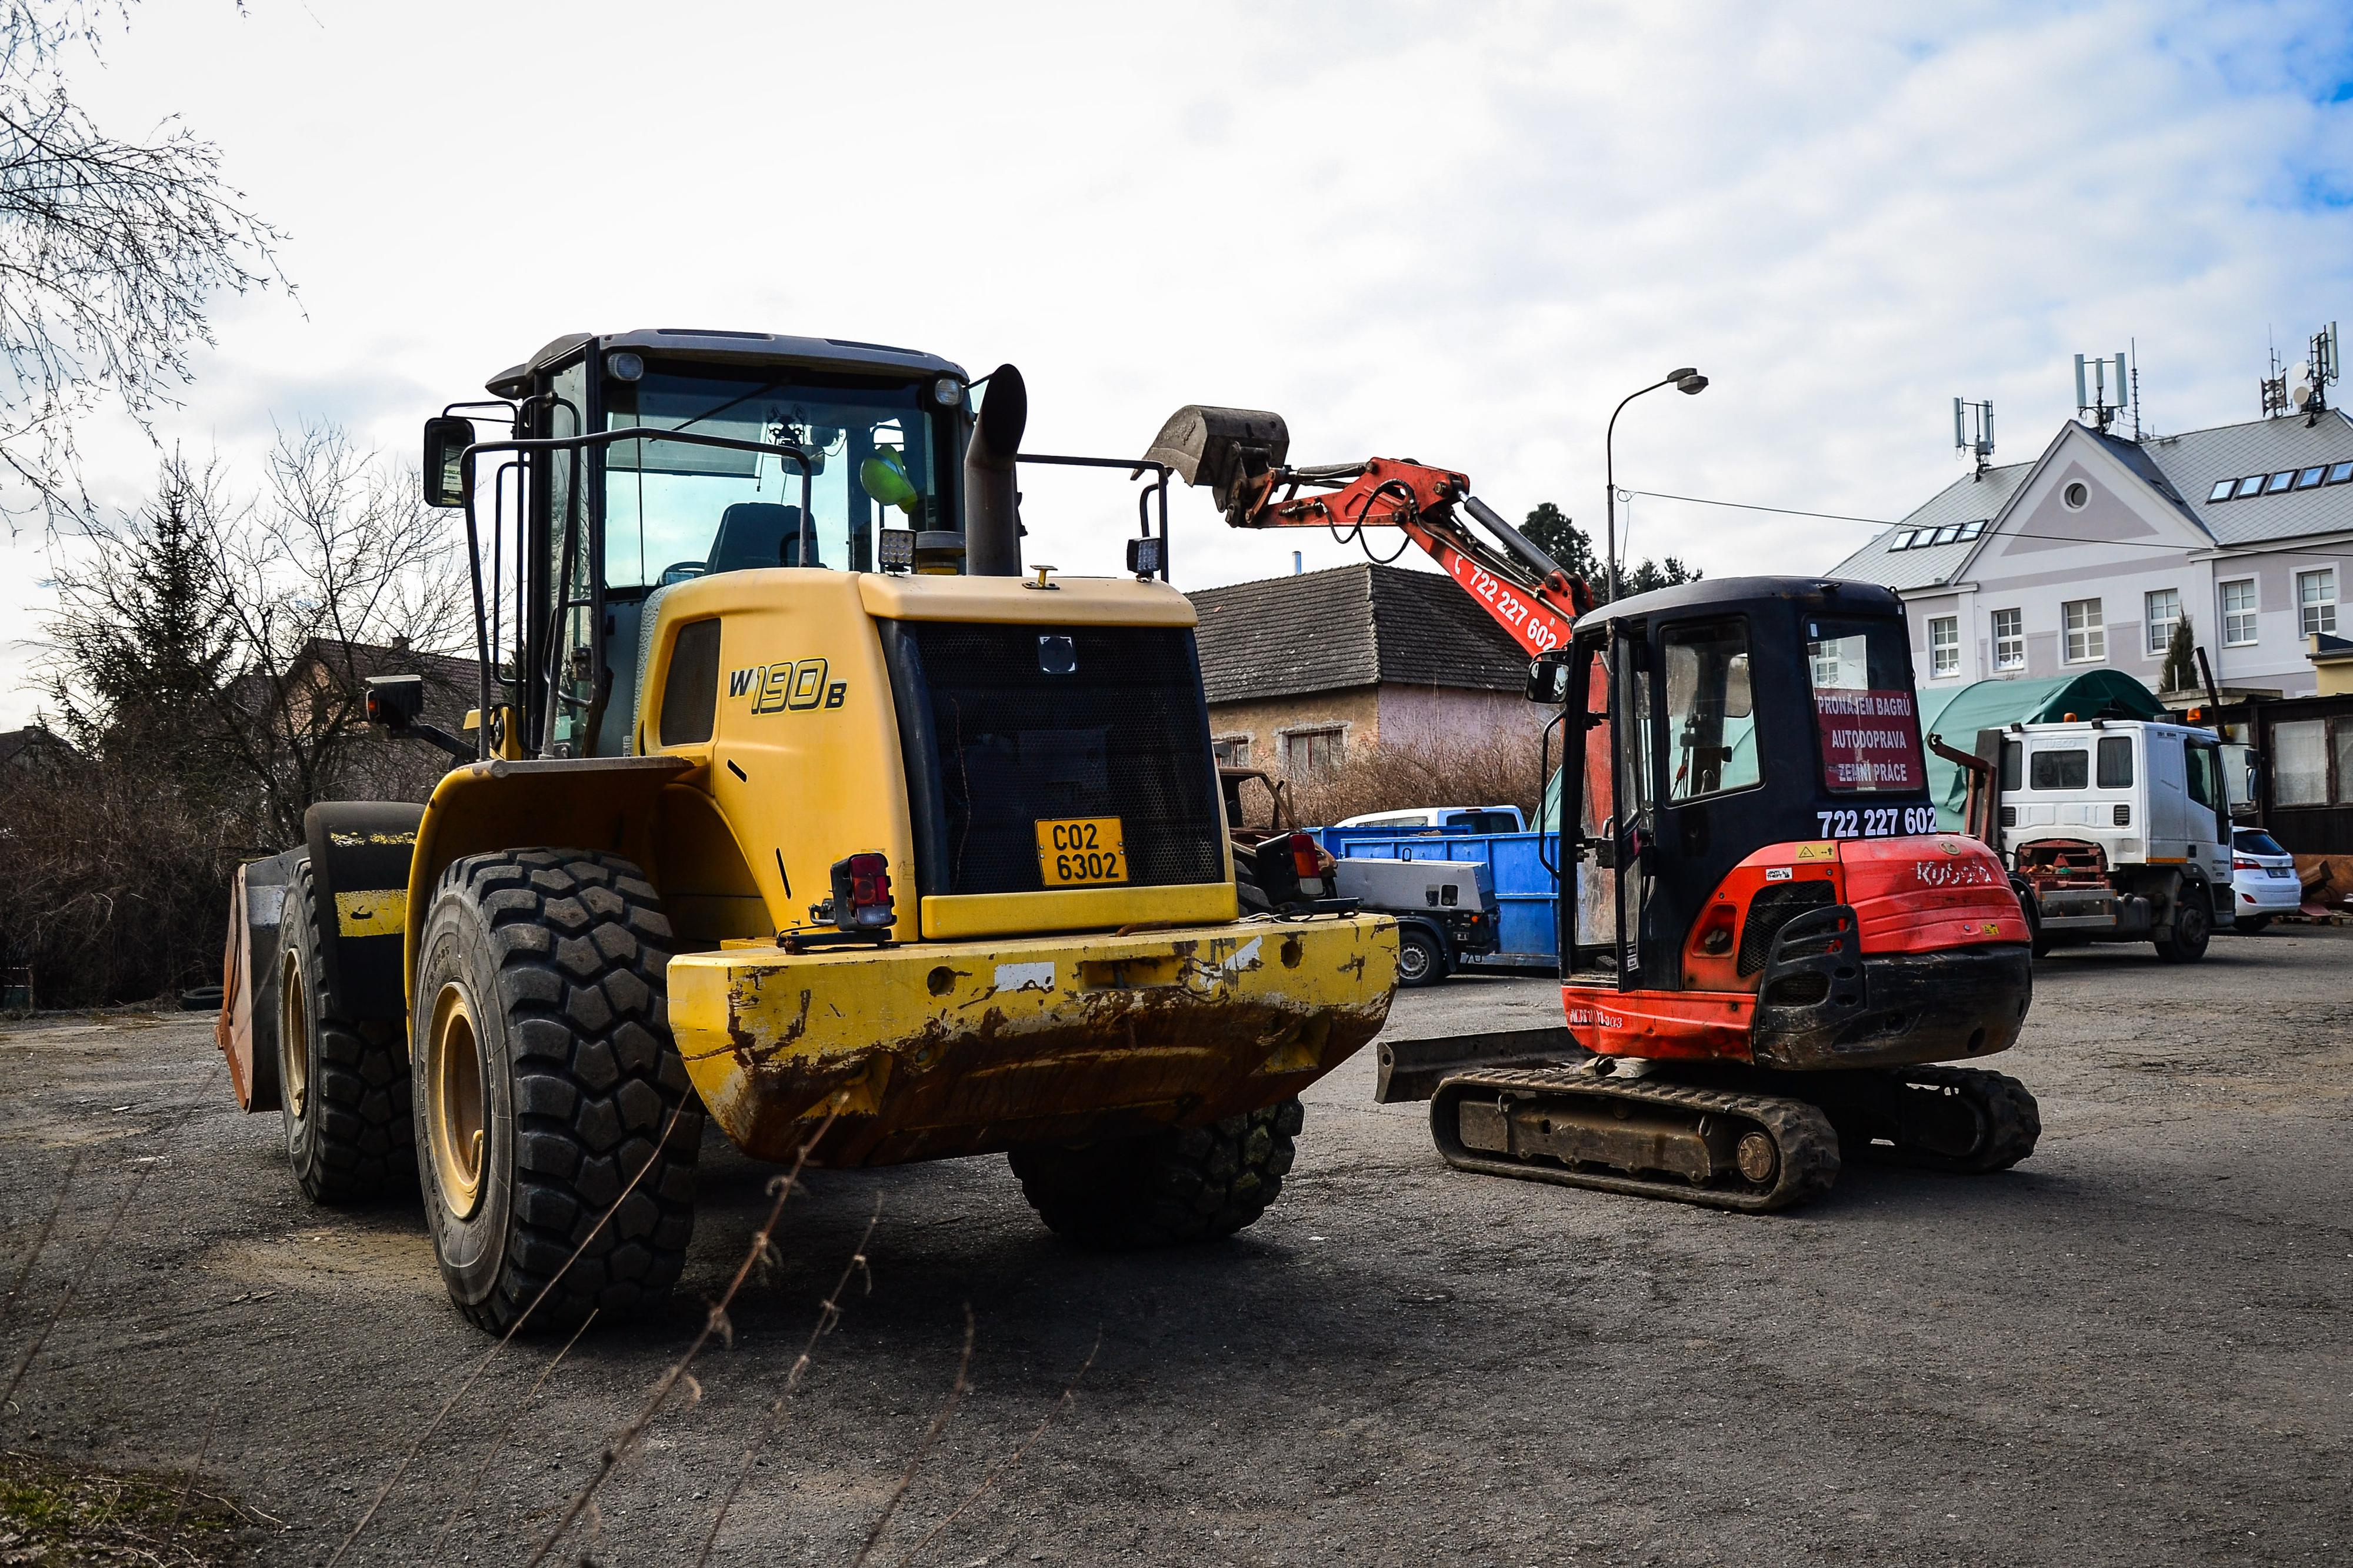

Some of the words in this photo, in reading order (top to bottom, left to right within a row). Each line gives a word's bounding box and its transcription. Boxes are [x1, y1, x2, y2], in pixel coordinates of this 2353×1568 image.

[1470, 565, 1498, 603] 722
[1496, 590, 1528, 626] 227
[1527, 618, 1557, 652] 602
[1877, 693, 1911, 716] BAGRŮ
[1832, 729, 1907, 749] AUTODOPRAVA
[1839, 759, 1871, 782] ZEMNÍ
[1875, 759, 1907, 781] PRÁCE
[1817, 810, 1859, 838] 722
[1864, 809, 1898, 836] 227
[1905, 807, 1937, 834] 602
[1056, 852, 1119, 880] 6302
